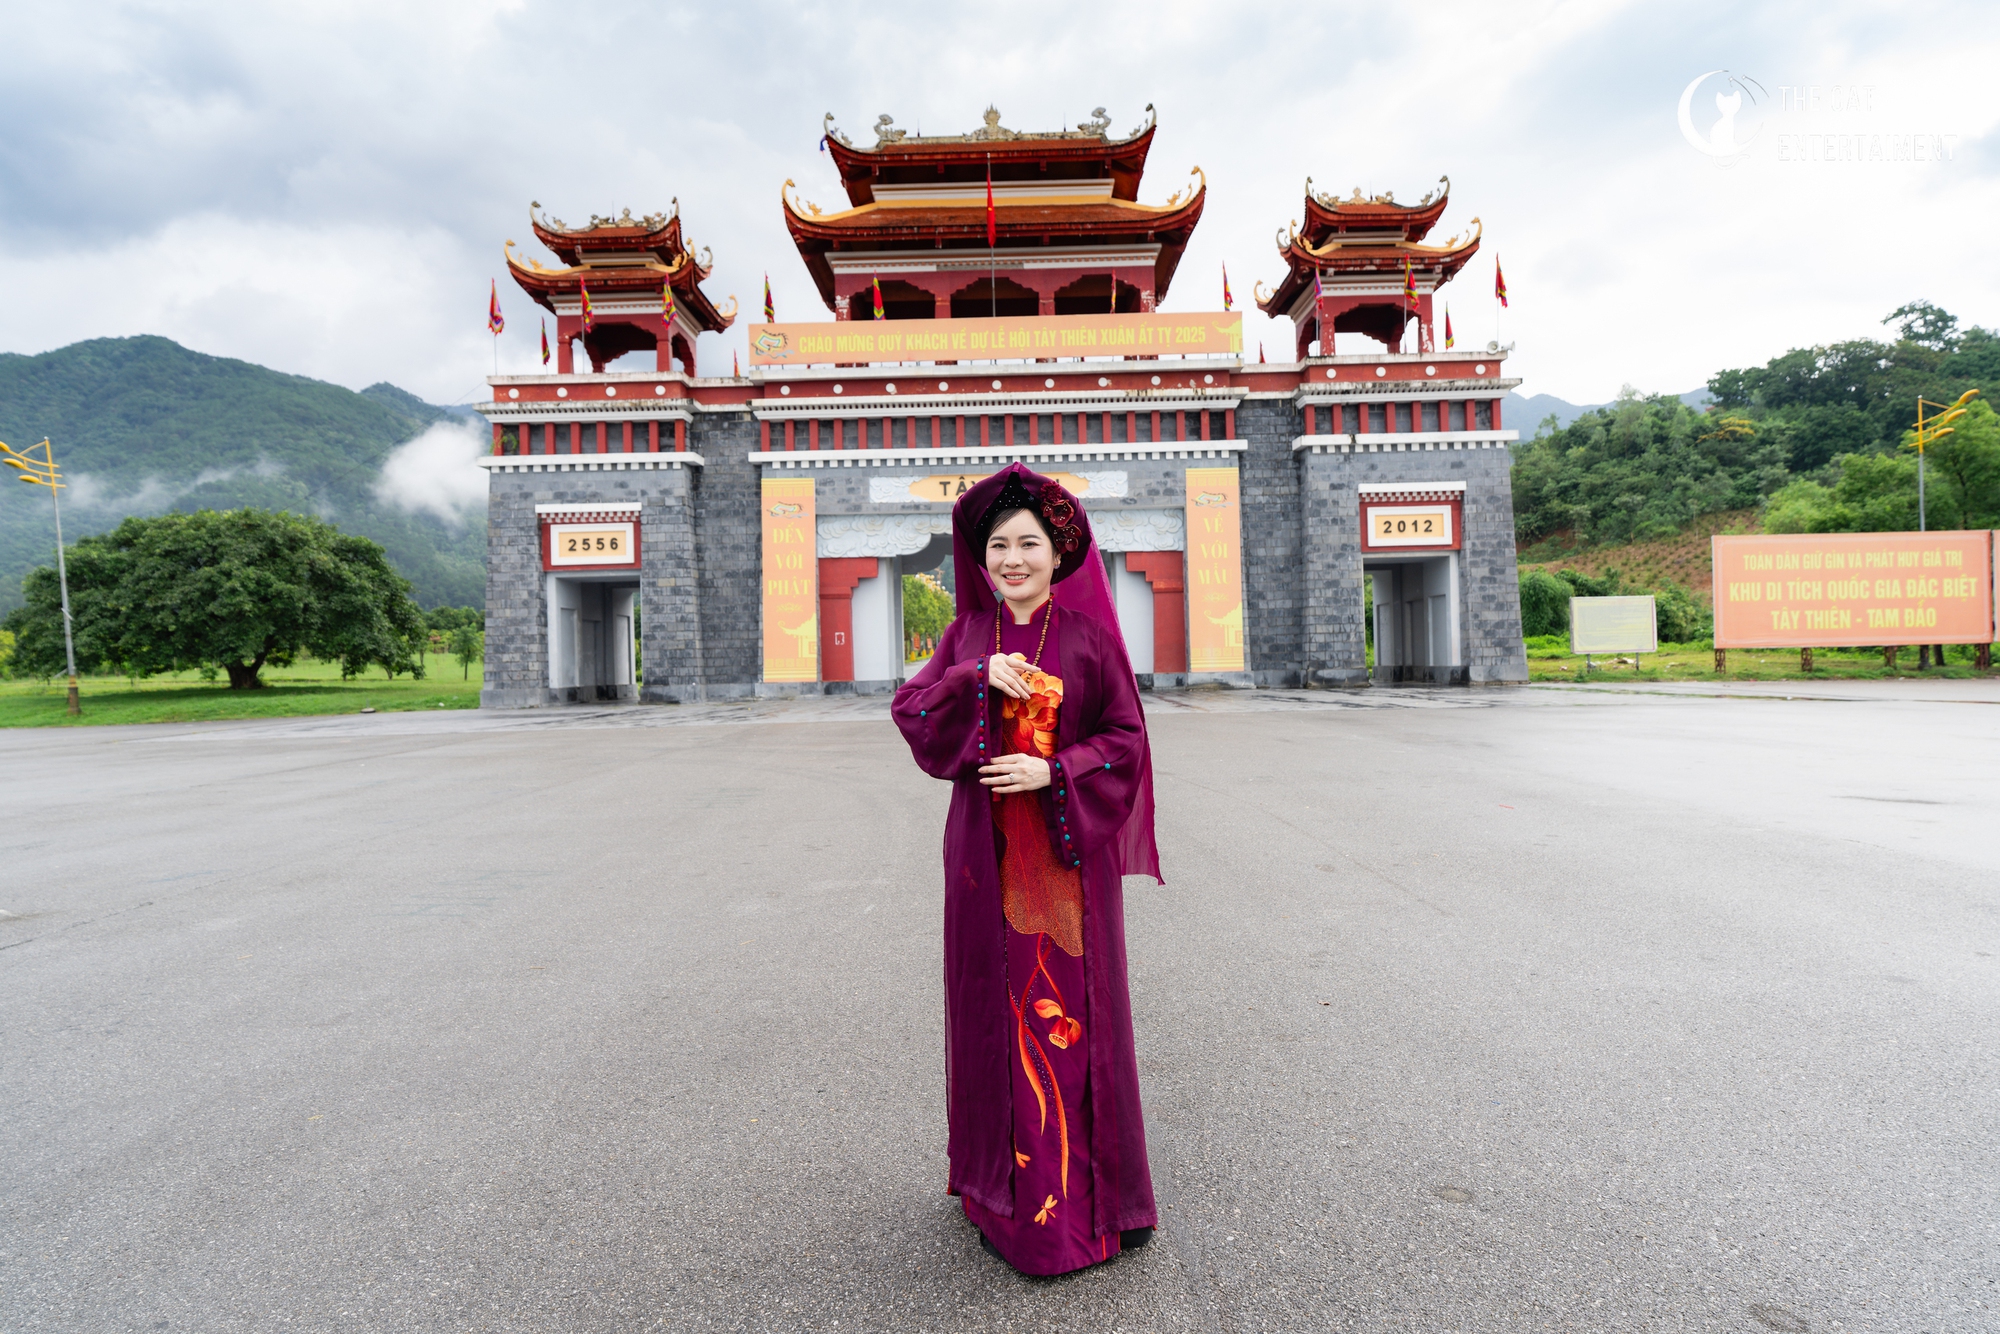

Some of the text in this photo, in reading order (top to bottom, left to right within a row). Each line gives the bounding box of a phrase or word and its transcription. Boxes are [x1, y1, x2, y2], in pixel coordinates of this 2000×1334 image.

[800, 321, 1206, 353] CHÀO MỪNG QUÝ KHÁCH VỀ DỰ LỄ HỘI TÂY THIÊN XUÂN ẤT TỴ 2025
[773, 522, 805, 544] ĐẾN
[1203, 511, 1224, 533] VỀ
[1383, 519, 1433, 534] 2012
[568, 537, 619, 551] 2556
[1200, 539, 1228, 559] VỚI
[775, 550, 803, 570] VỚI
[1743, 550, 1773, 570] TOÀN
[1847, 548, 1862, 568] VÀ
[1865, 547, 1895, 568] PHÁT
[1897, 551, 1919, 567] HUY
[1922, 547, 1942, 567] GIÁ
[1944, 550, 1963, 570] TRỊ
[767, 576, 811, 598] PHẬT
[1729, 581, 1761, 602] KHU
[1766, 581, 1782, 601] DI
[1786, 576, 1823, 600] TÍCH
[1827, 573, 1870, 602] QUỐC
[1875, 579, 1902, 599] GIA
[1943, 573, 1978, 602] BIỆT
[1771, 605, 1800, 630] TÂY
[1804, 605, 1851, 629] THIÊN
[1866, 608, 1900, 628] TAM
